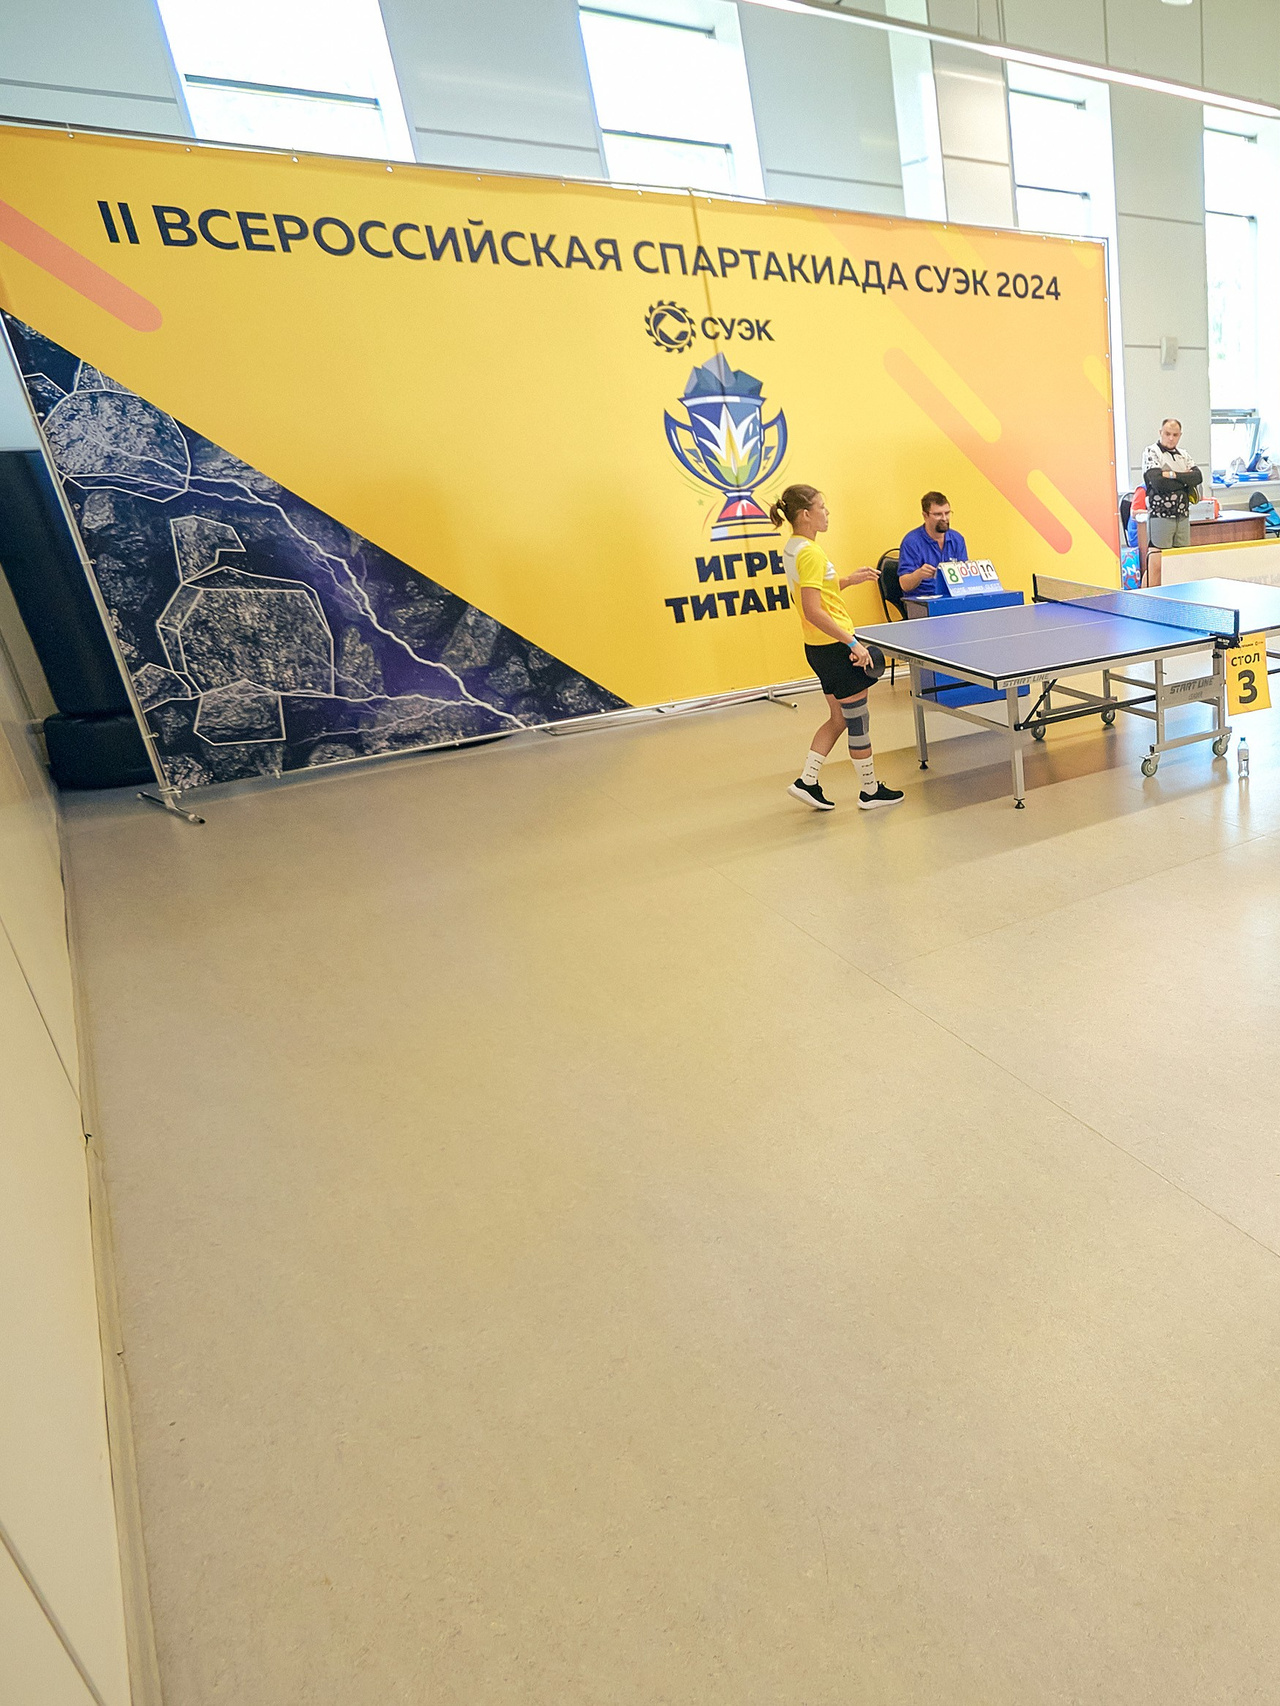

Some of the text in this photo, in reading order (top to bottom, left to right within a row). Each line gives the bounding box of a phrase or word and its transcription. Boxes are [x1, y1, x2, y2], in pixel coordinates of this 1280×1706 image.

[97, 200, 1061, 300] II ВСЕРОССИЙСКАЯ СПАРТАКИАДА СУЭК 2024
[701, 316, 775, 341] СУЭК
[947, 567, 959, 583] 8
[960, 566, 968, 576] 0
[970, 565, 978, 575] 0
[664, 585, 795, 624] ТИТАН
[1231, 652, 1260, 667] СТОЛ
[1169, 677, 1214, 695] START LINE
[1237, 669, 1258, 704] 3
